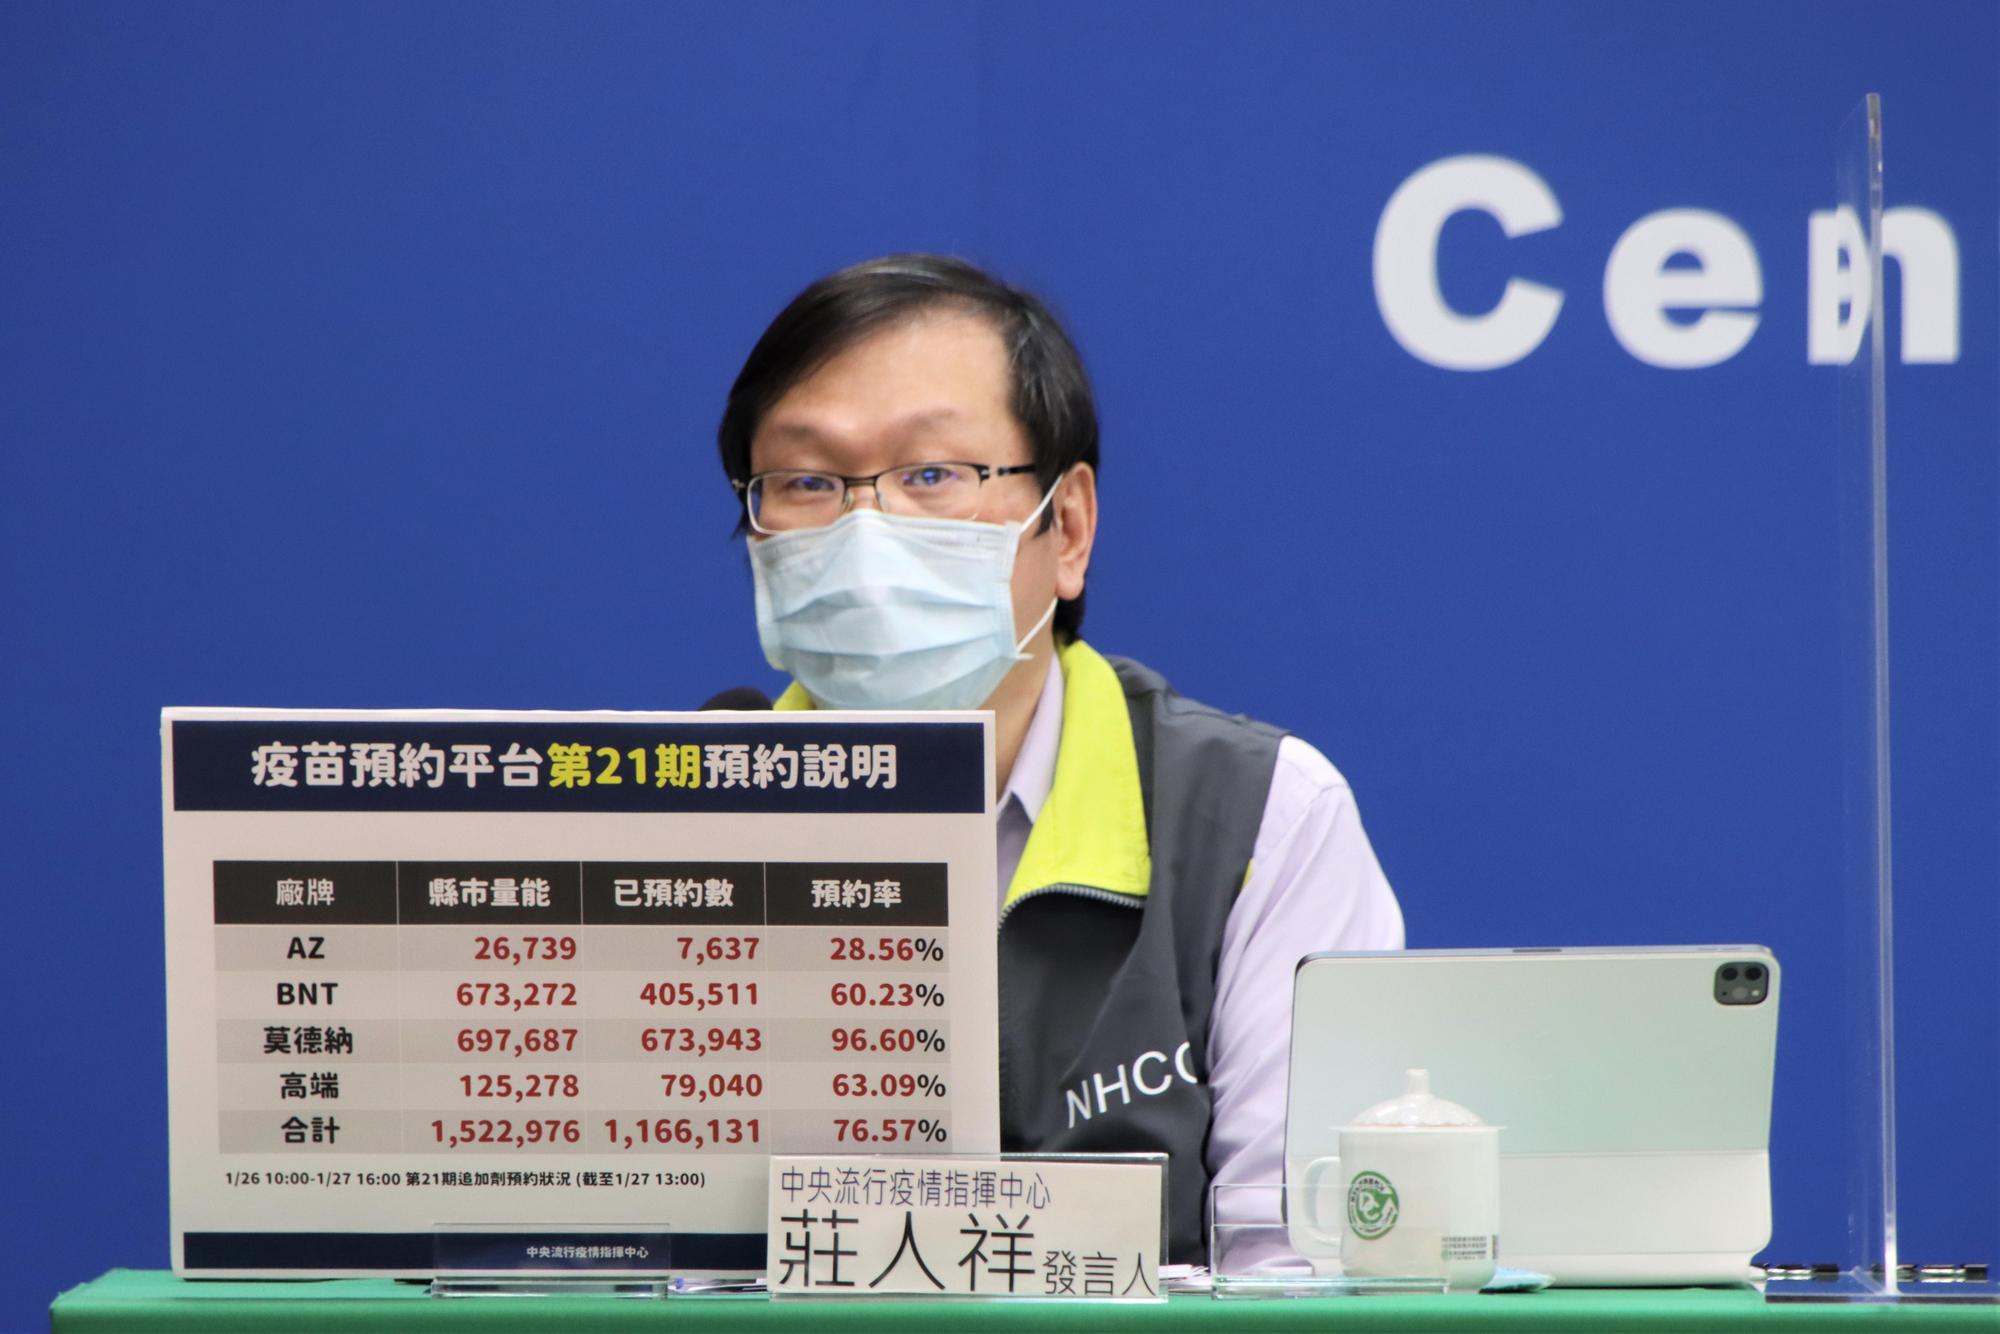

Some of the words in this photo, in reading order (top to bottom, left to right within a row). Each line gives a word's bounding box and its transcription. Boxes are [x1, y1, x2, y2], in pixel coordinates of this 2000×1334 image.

[1372, 153, 1960, 371] Cen
[251, 740, 897, 789] 疫苗預約平台第21期預約說明
[276, 878, 335, 906] 廠牌
[429, 877, 551, 907] 縣市量能
[613, 878, 734, 908] 已預約數
[810, 878, 902, 909] 預約率
[286, 936, 325, 960] AZ
[474, 936, 577, 966] 26,739
[676, 936, 760, 966] 7,637
[830, 937, 944, 962] 28.56%
[276, 982, 339, 1006] BNT
[456, 982, 577, 1012] 673,272
[639, 982, 758, 1012] 405,511
[831, 982, 945, 1007] 60.23%
[263, 1026, 353, 1055] 莫德納
[457, 1028, 578, 1058] 697,687
[641, 1027, 762, 1057] 673,943
[831, 1028, 946, 1053] 96.60%
[280, 1071, 339, 1100] 高端
[459, 1074, 580, 1103] 125,278
[660, 1073, 763, 1103] 79,040
[832, 1073, 947, 1098] 63.09%
[280, 1116, 341, 1145] 合計
[431, 1119, 581, 1149] 1,522,976
[604, 1118, 759, 1150] 1,166,131
[833, 1118, 948, 1143] 76.57%
[226, 1172, 261, 1187] 1/26
[265, 1172, 352, 1188] 10:00-1/27
[357, 1172, 401, 1186] 16:00
[406, 1171, 571, 1187] 第21期追加劑預約狀況
[576, 1171, 650, 1188] (截至1/27
[655, 1172, 705, 1188] 13:00)
[780, 1165, 1051, 1210] 中央流行疫情指揮中心
[526, 1246, 649, 1259] 中央流行疫情指揮中心
[779, 1208, 1036, 1293] 莊人祥
[1042, 1250, 1156, 1296] 發言人
